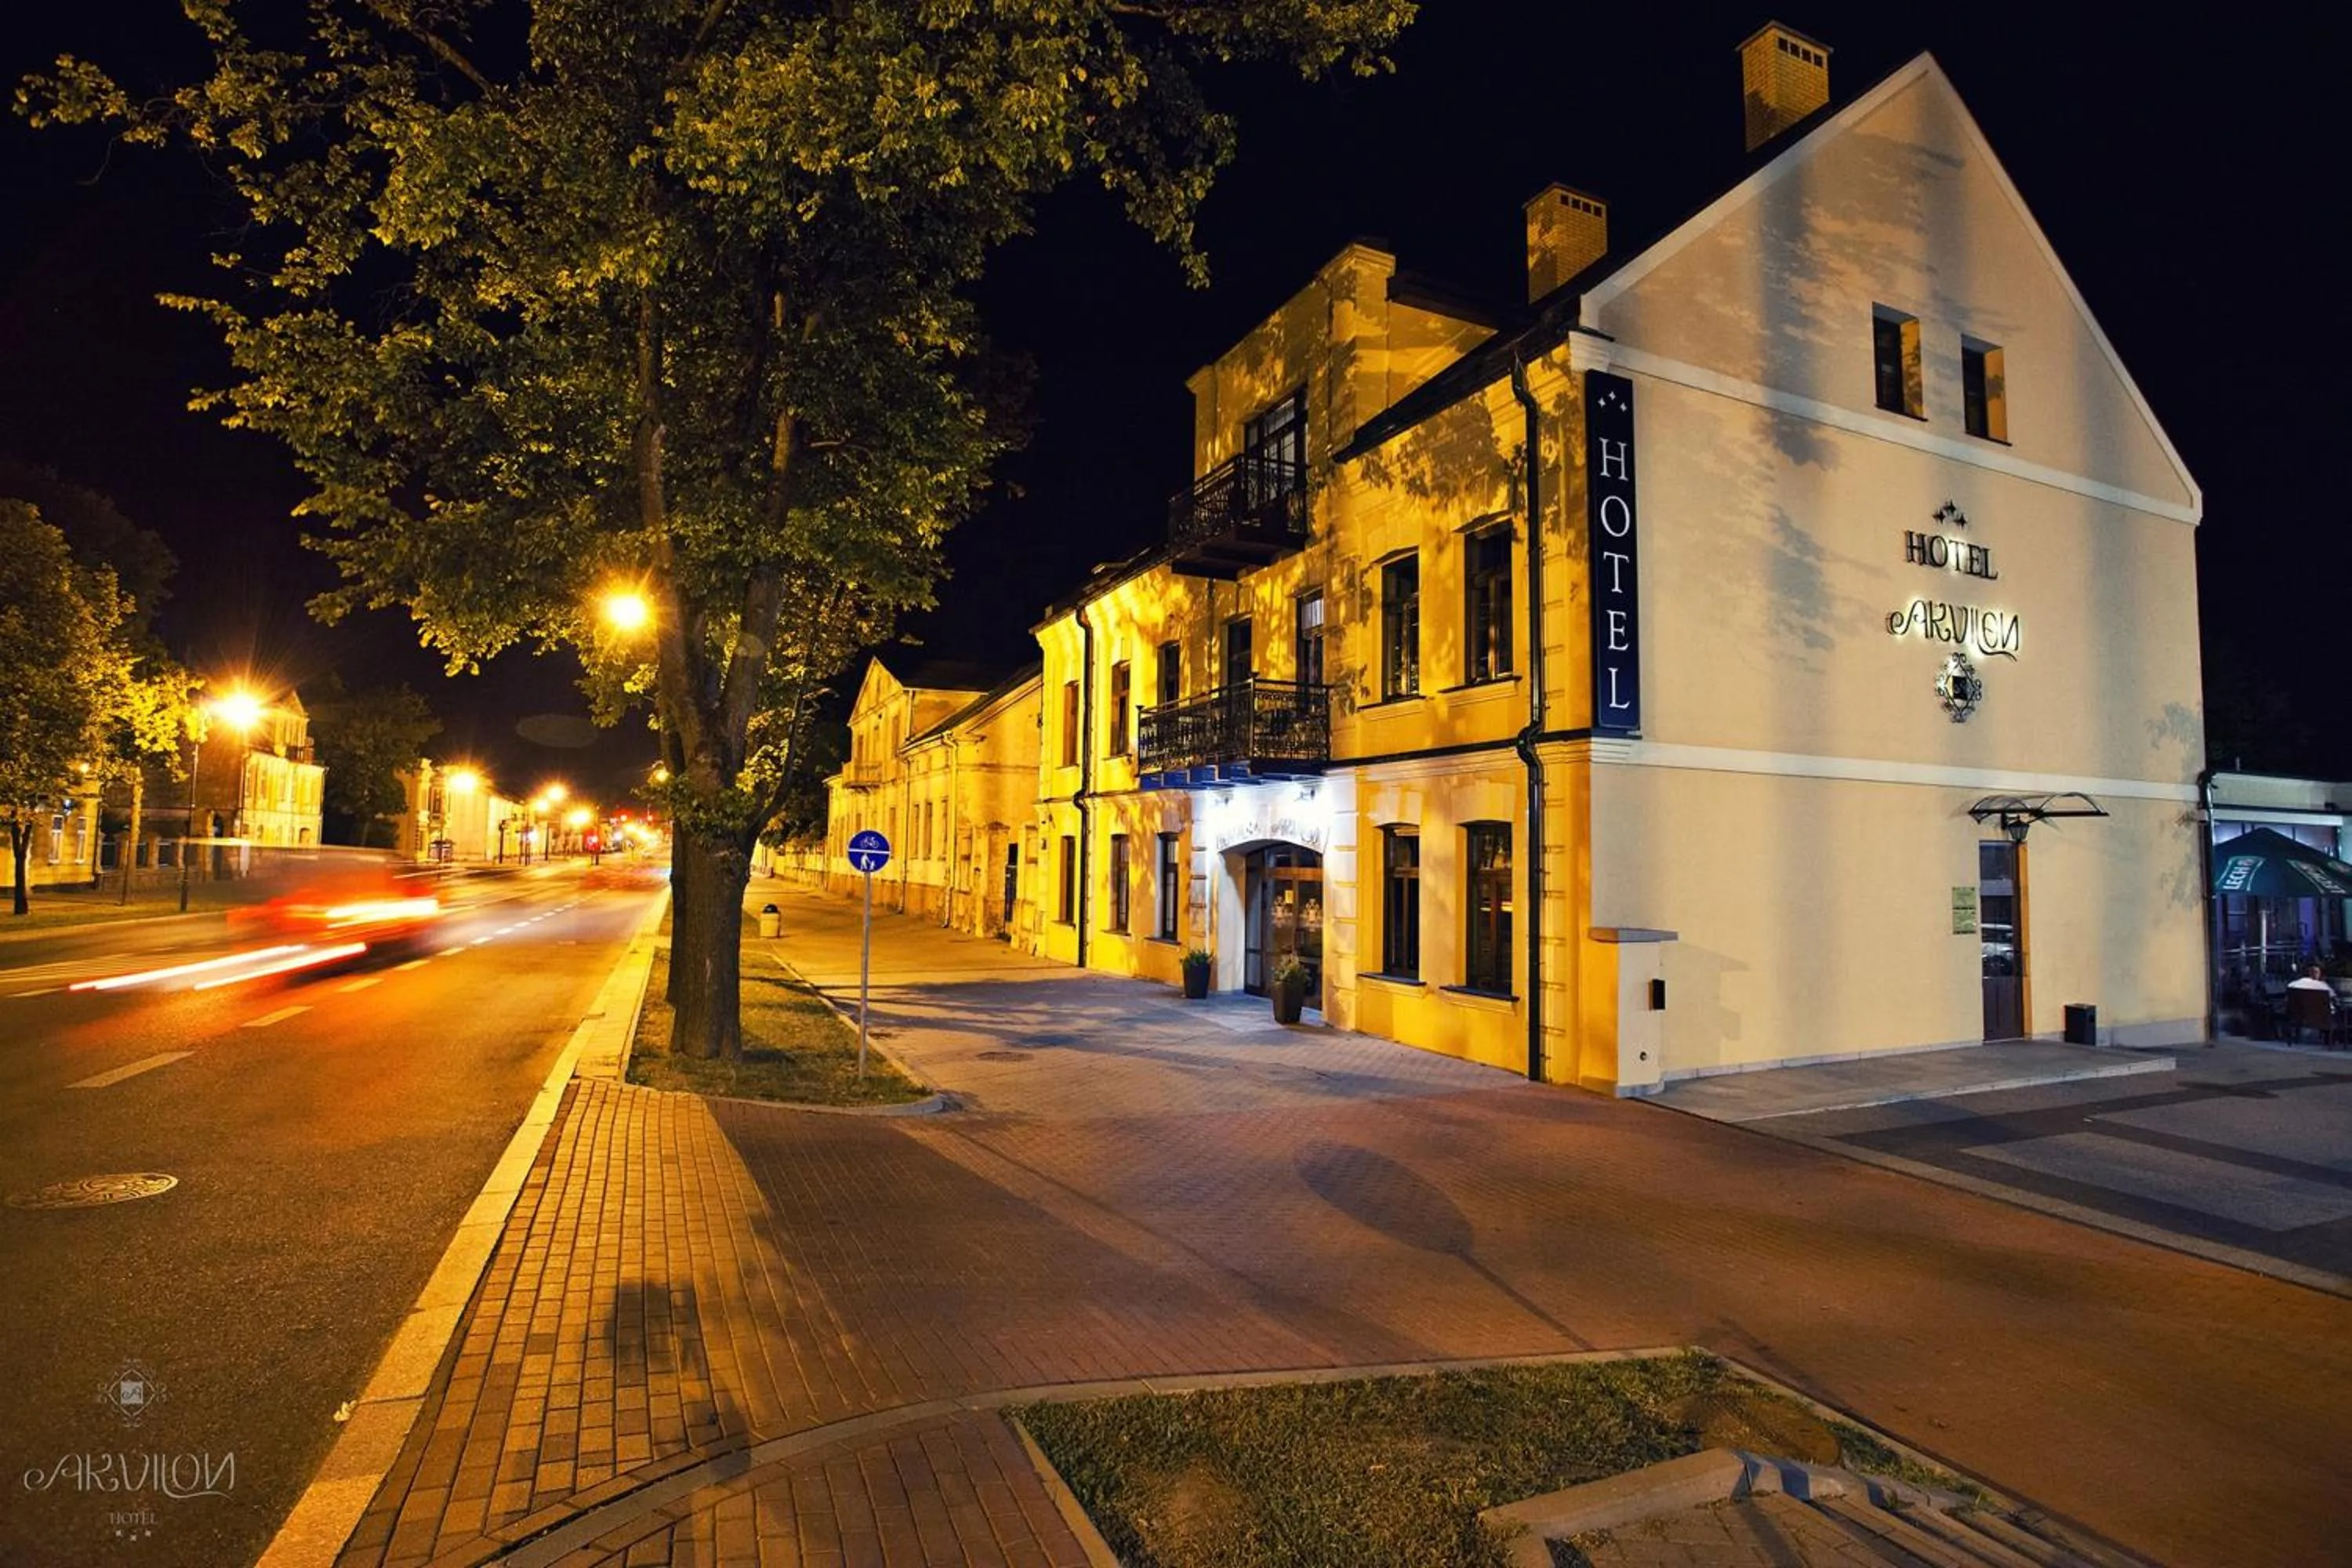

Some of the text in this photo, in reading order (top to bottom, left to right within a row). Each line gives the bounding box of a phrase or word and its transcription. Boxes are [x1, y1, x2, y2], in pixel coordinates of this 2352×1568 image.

[1599, 437, 1630, 709] HOTEL
[1905, 530, 1998, 580] HOTEL
[2222, 866, 2250, 891] LECH
